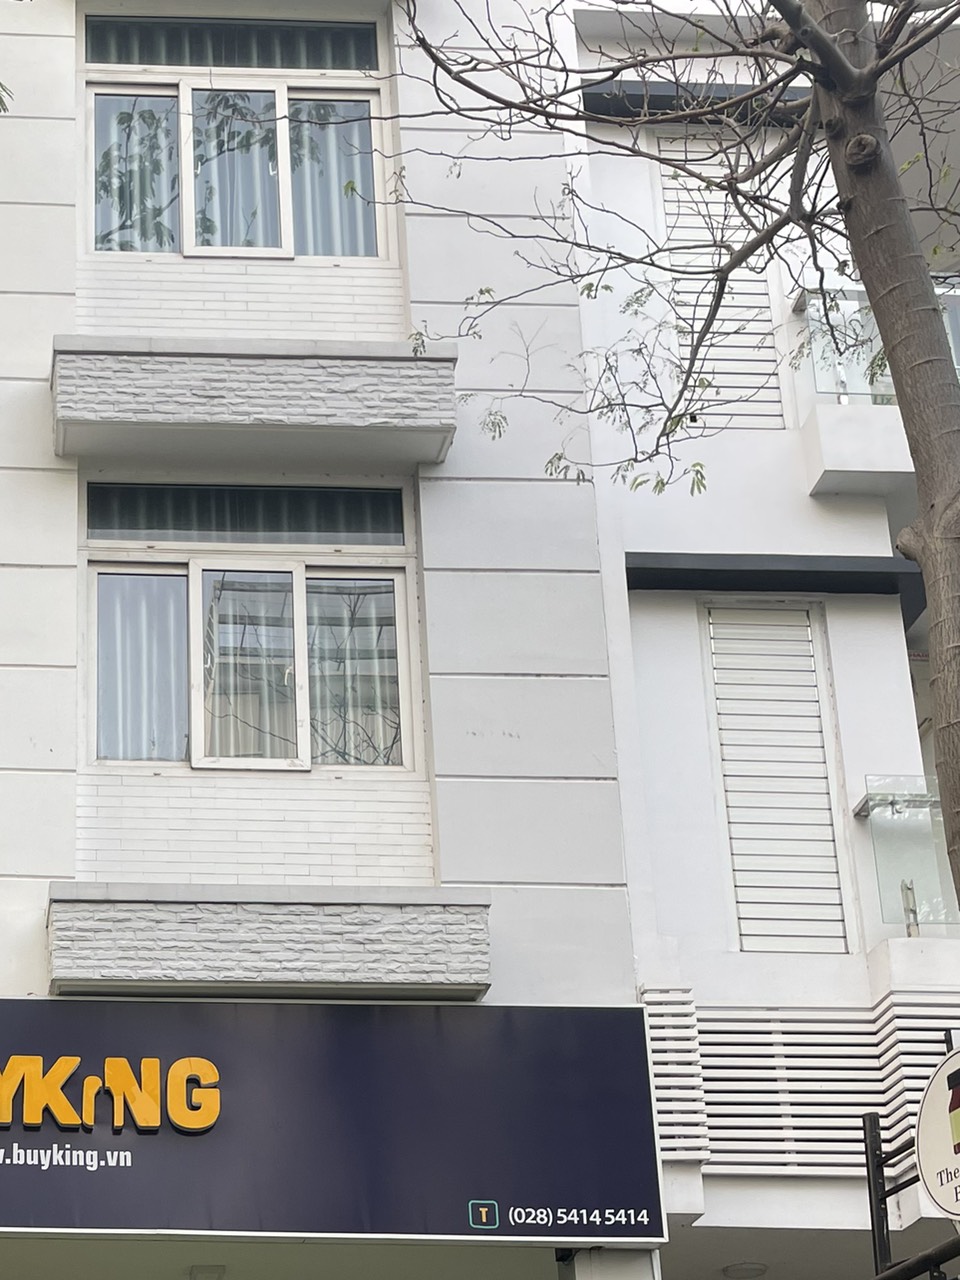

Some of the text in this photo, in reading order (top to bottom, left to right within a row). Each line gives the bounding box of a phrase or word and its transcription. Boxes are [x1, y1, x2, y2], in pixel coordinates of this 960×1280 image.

[936, 1167, 960, 1188] The
[479, 1207, 649, 1226] T (028) 5414 5414
